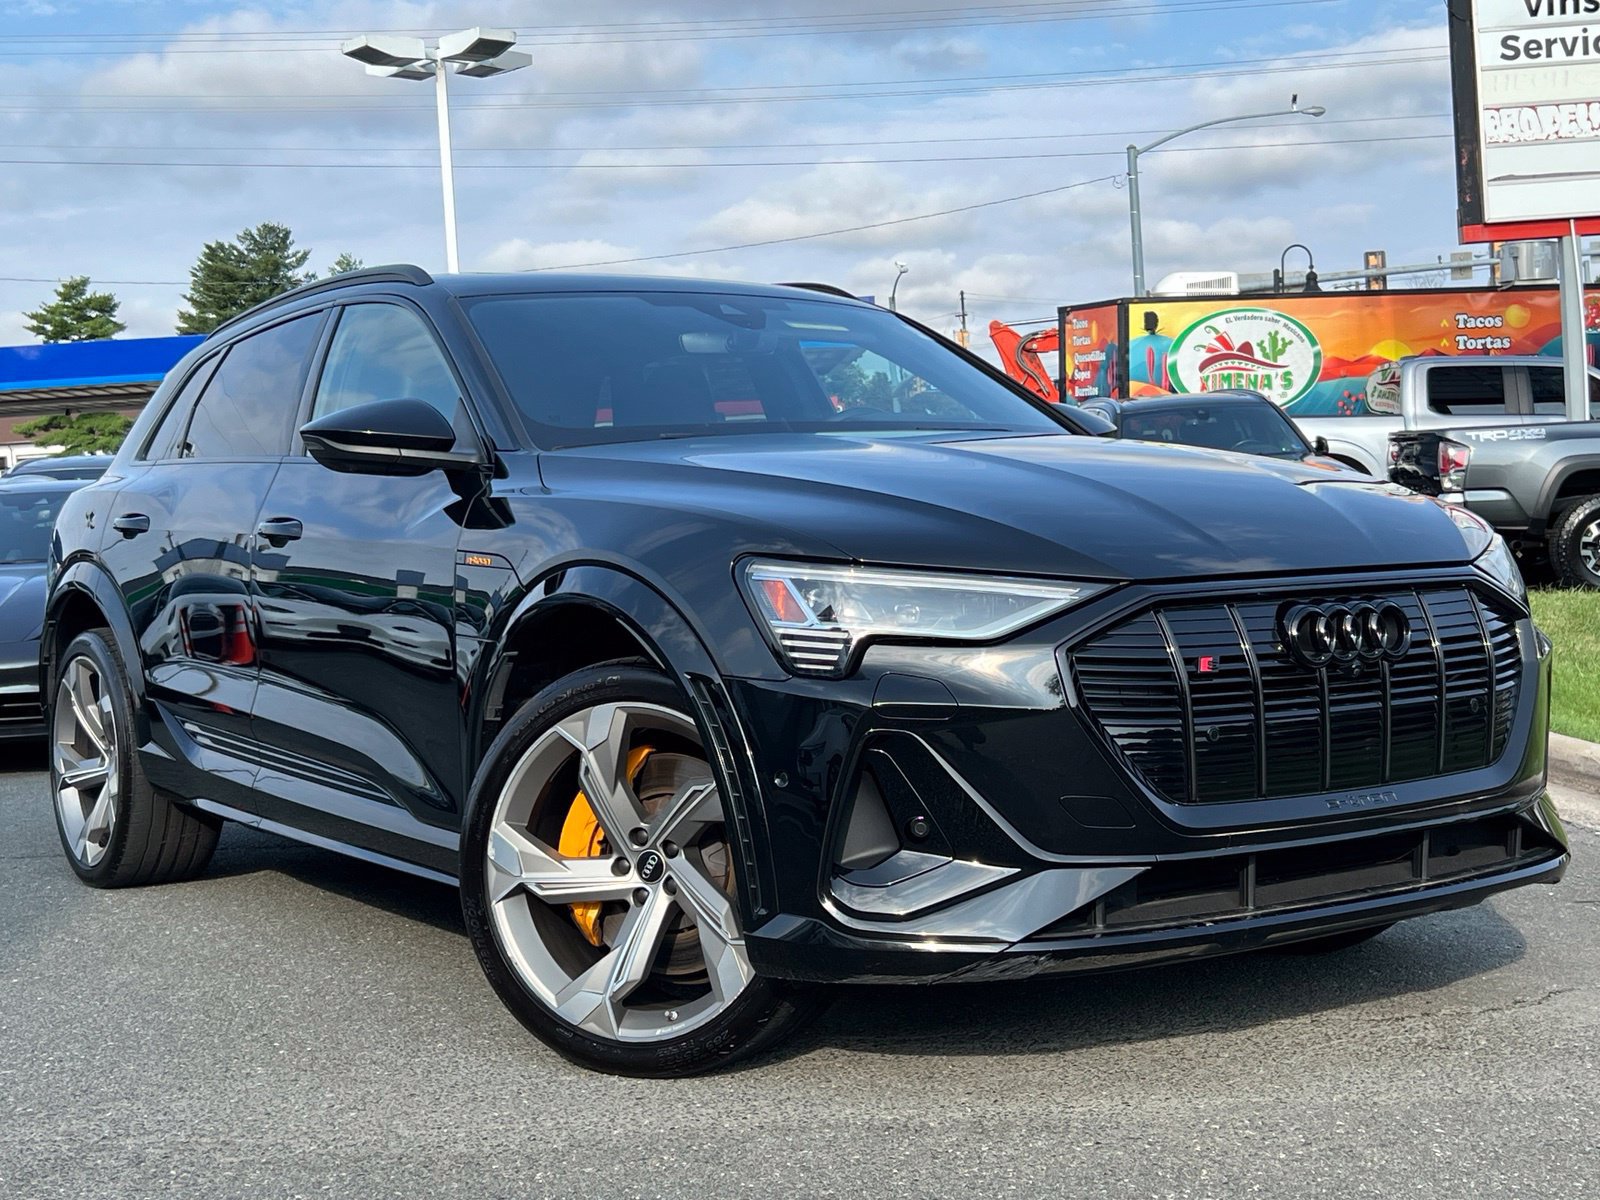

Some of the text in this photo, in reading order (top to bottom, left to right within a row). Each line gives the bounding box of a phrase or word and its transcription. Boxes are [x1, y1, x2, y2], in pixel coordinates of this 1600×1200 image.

[1072, 319, 1089, 329] Tacos
[1455, 313, 1503, 329] Tacos
[1072, 335, 1091, 346] Tortas
[1455, 335, 1511, 350] Tortas
[1074, 369, 1091, 382] Sopes
[1200, 371, 1294, 392] XIMENA'S
[1074, 385, 1099, 397] Burritos
